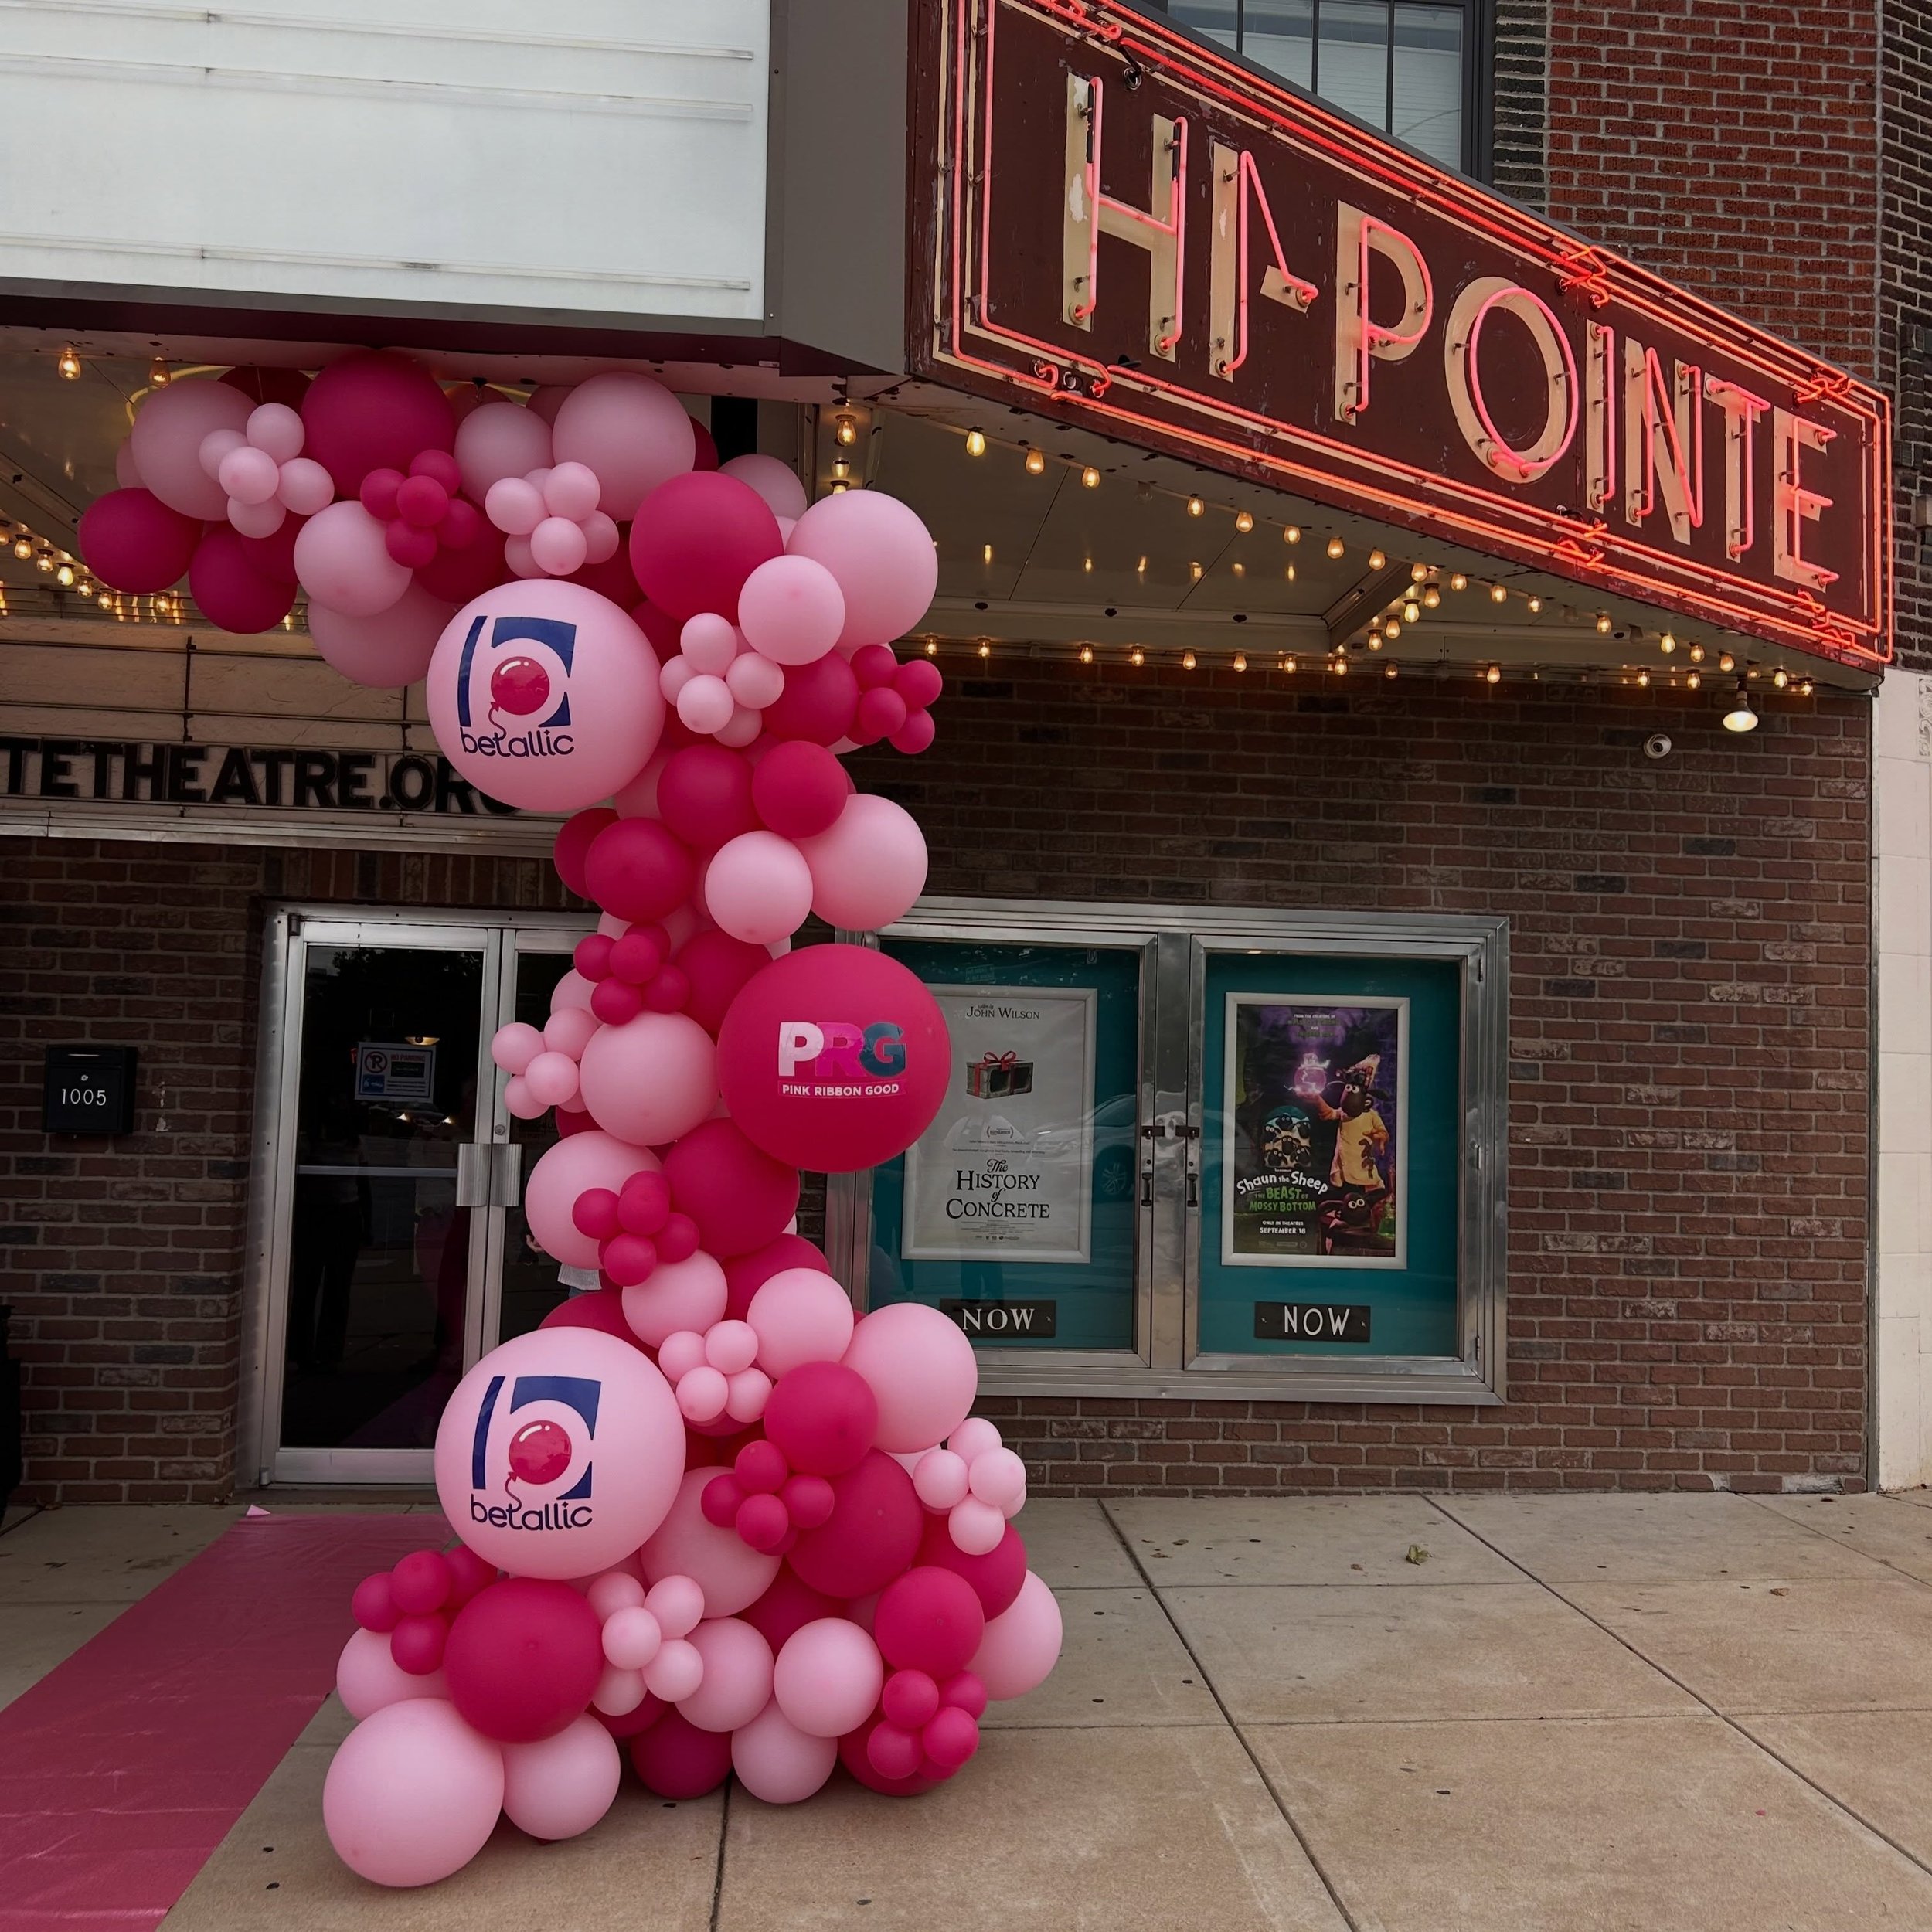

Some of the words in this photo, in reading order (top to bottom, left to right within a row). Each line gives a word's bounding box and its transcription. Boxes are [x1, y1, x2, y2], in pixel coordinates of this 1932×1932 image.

[1063, 72, 1839, 594] HI-POINTE
[460, 726, 575, 757] betallic
[0, 736, 519, 815] TETHEATRE.OR
[966, 1006, 995, 1018] JOHN
[998, 1007, 1040, 1019] WILSON
[778, 1022, 906, 1078] PRG
[62, 1088, 107, 1106] 1005
[782, 1084, 811, 1096] PINK
[814, 1086, 862, 1097] RIBBON
[865, 1083, 900, 1096] GOOD
[987, 1158, 1008, 1173] The
[956, 1170, 1040, 1190] HISTORY
[1236, 1174, 1277, 1195] Shaun
[1291, 1171, 1328, 1195] Sheep
[991, 1188, 1006, 1202] of
[1266, 1186, 1302, 1199] BEAST
[946, 1198, 1049, 1219] CONCRETE
[1249, 1201, 1278, 1211] MOSSY
[1279, 1201, 1316, 1212] BOTTOM
[962, 1308, 1035, 1331] NOW
[1284, 1305, 1350, 1335] NOW
[471, 1493, 593, 1530] betallic
